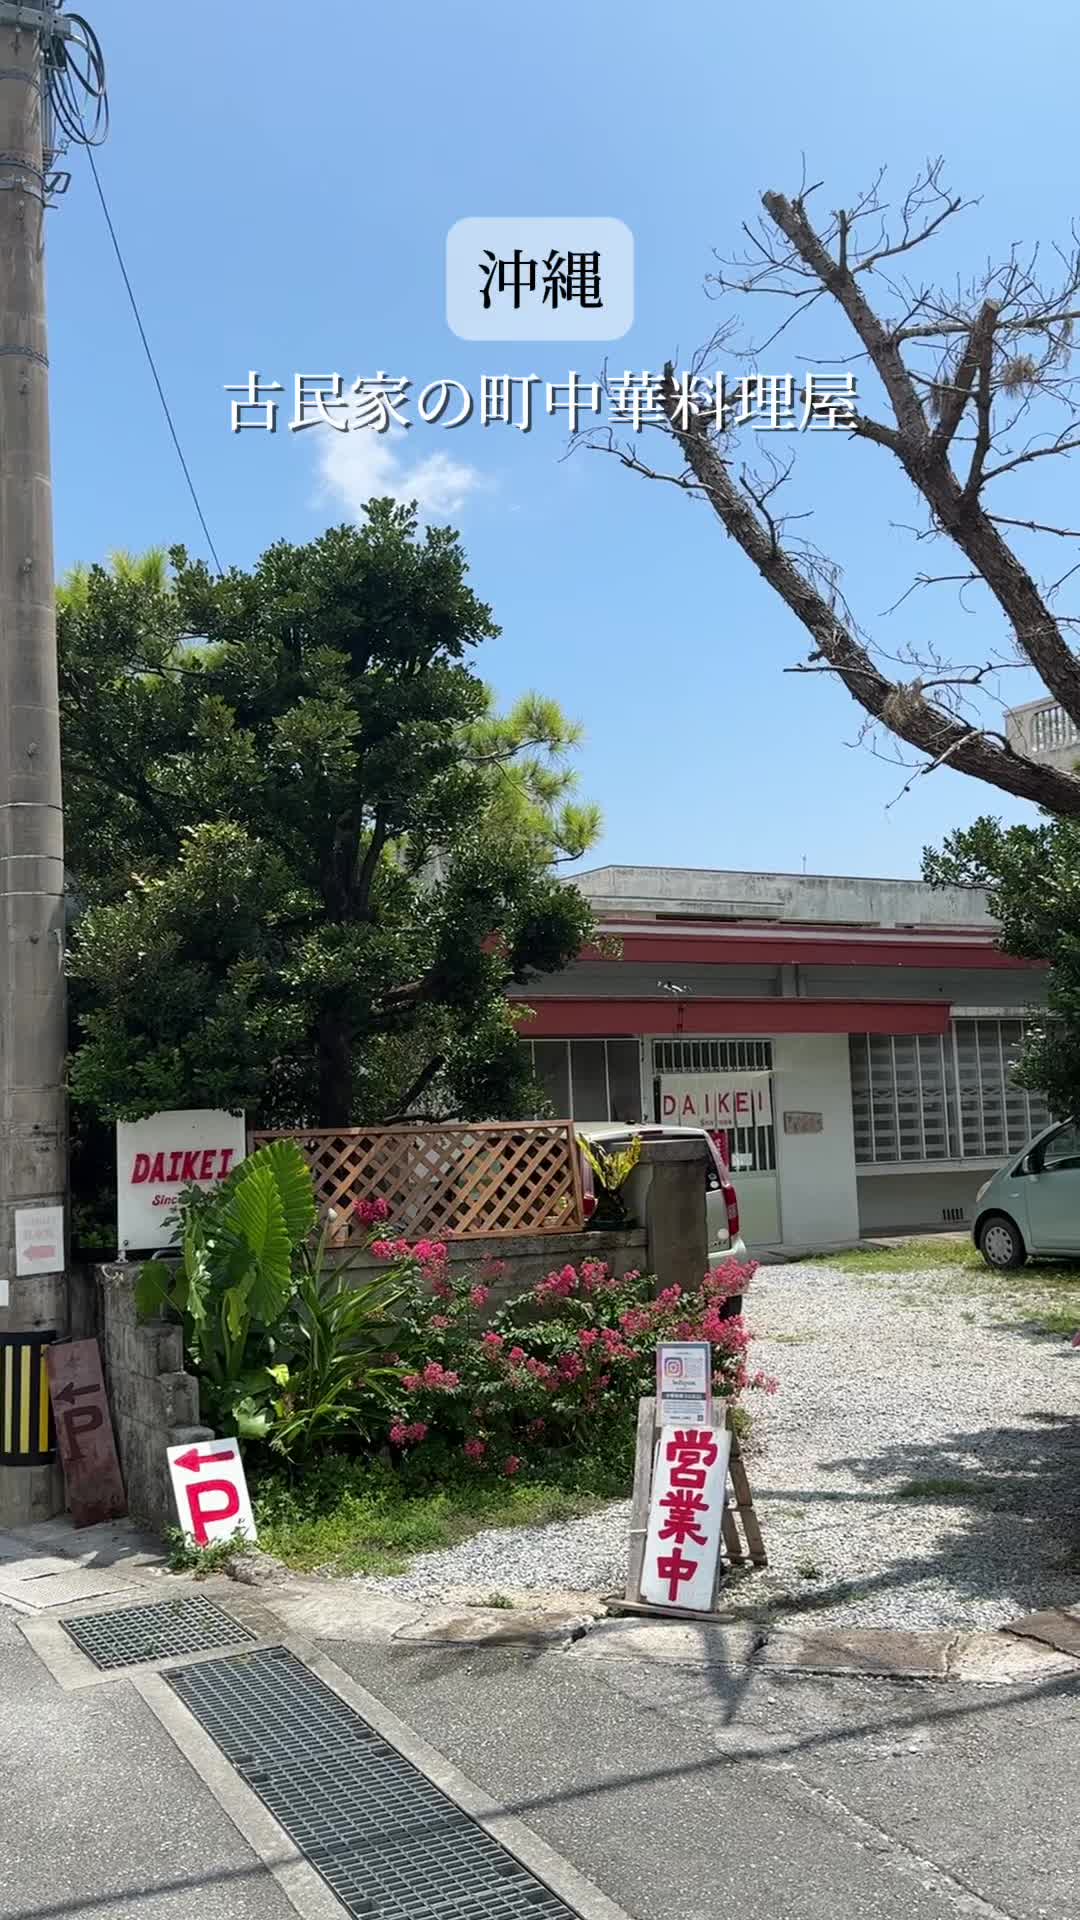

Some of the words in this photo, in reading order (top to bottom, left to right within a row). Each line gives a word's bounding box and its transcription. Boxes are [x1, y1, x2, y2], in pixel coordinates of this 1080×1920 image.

[663, 1091, 763, 1115] DAIKEI
[131, 1149, 235, 1184] DAIKEI
[152, 1194, 181, 1206] Sinc
[64, 1405, 103, 1462] P
[186, 1479, 240, 1549] P
[657, 1429, 718, 1602] 営業中
